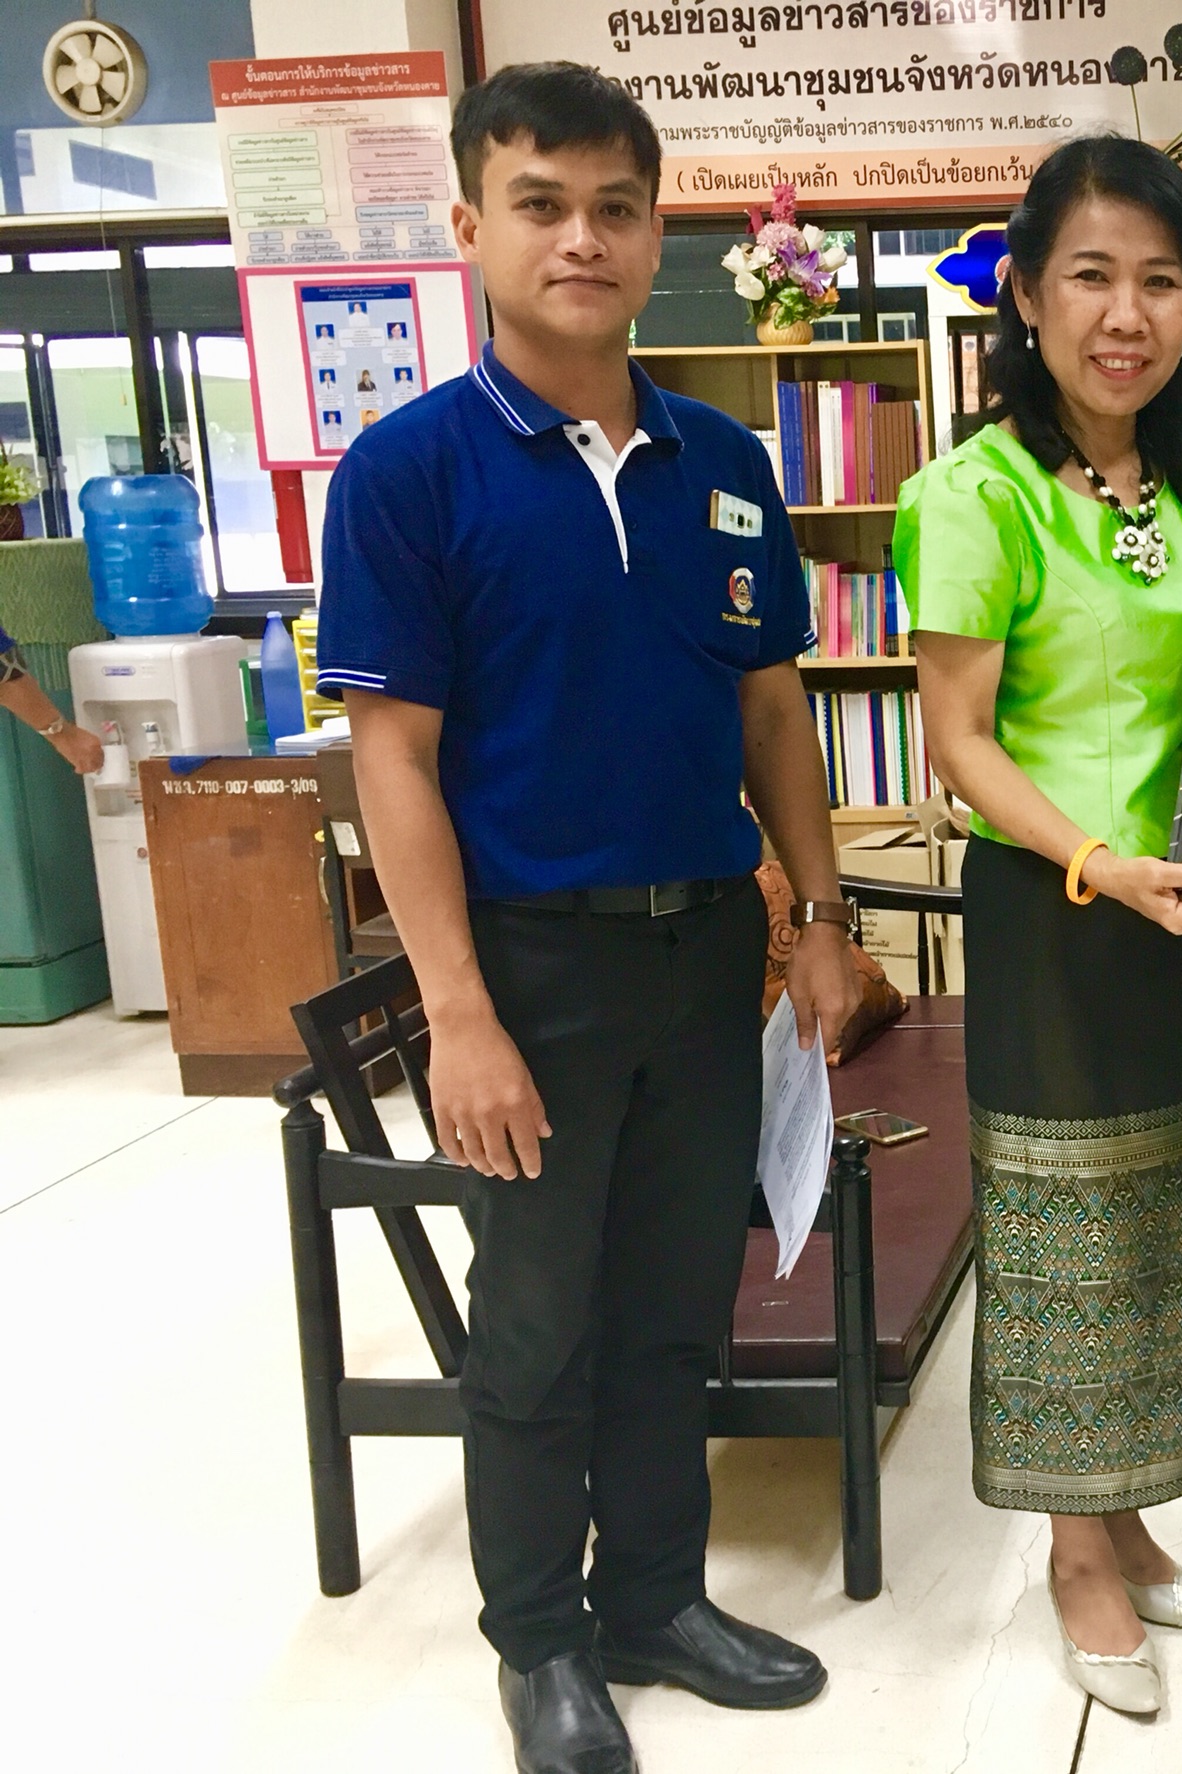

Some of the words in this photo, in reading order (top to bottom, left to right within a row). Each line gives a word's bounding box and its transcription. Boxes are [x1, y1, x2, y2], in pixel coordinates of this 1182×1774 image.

[655, 116, 984, 144] ามพระราชบัญญัติข้อมูลข่าวสารของราชการ
[989, 114, 1073, 131] พ.ศ.๒๕๔๐
[852, 156, 1033, 186] ปกปิดเป็นข้อยกเว้น
